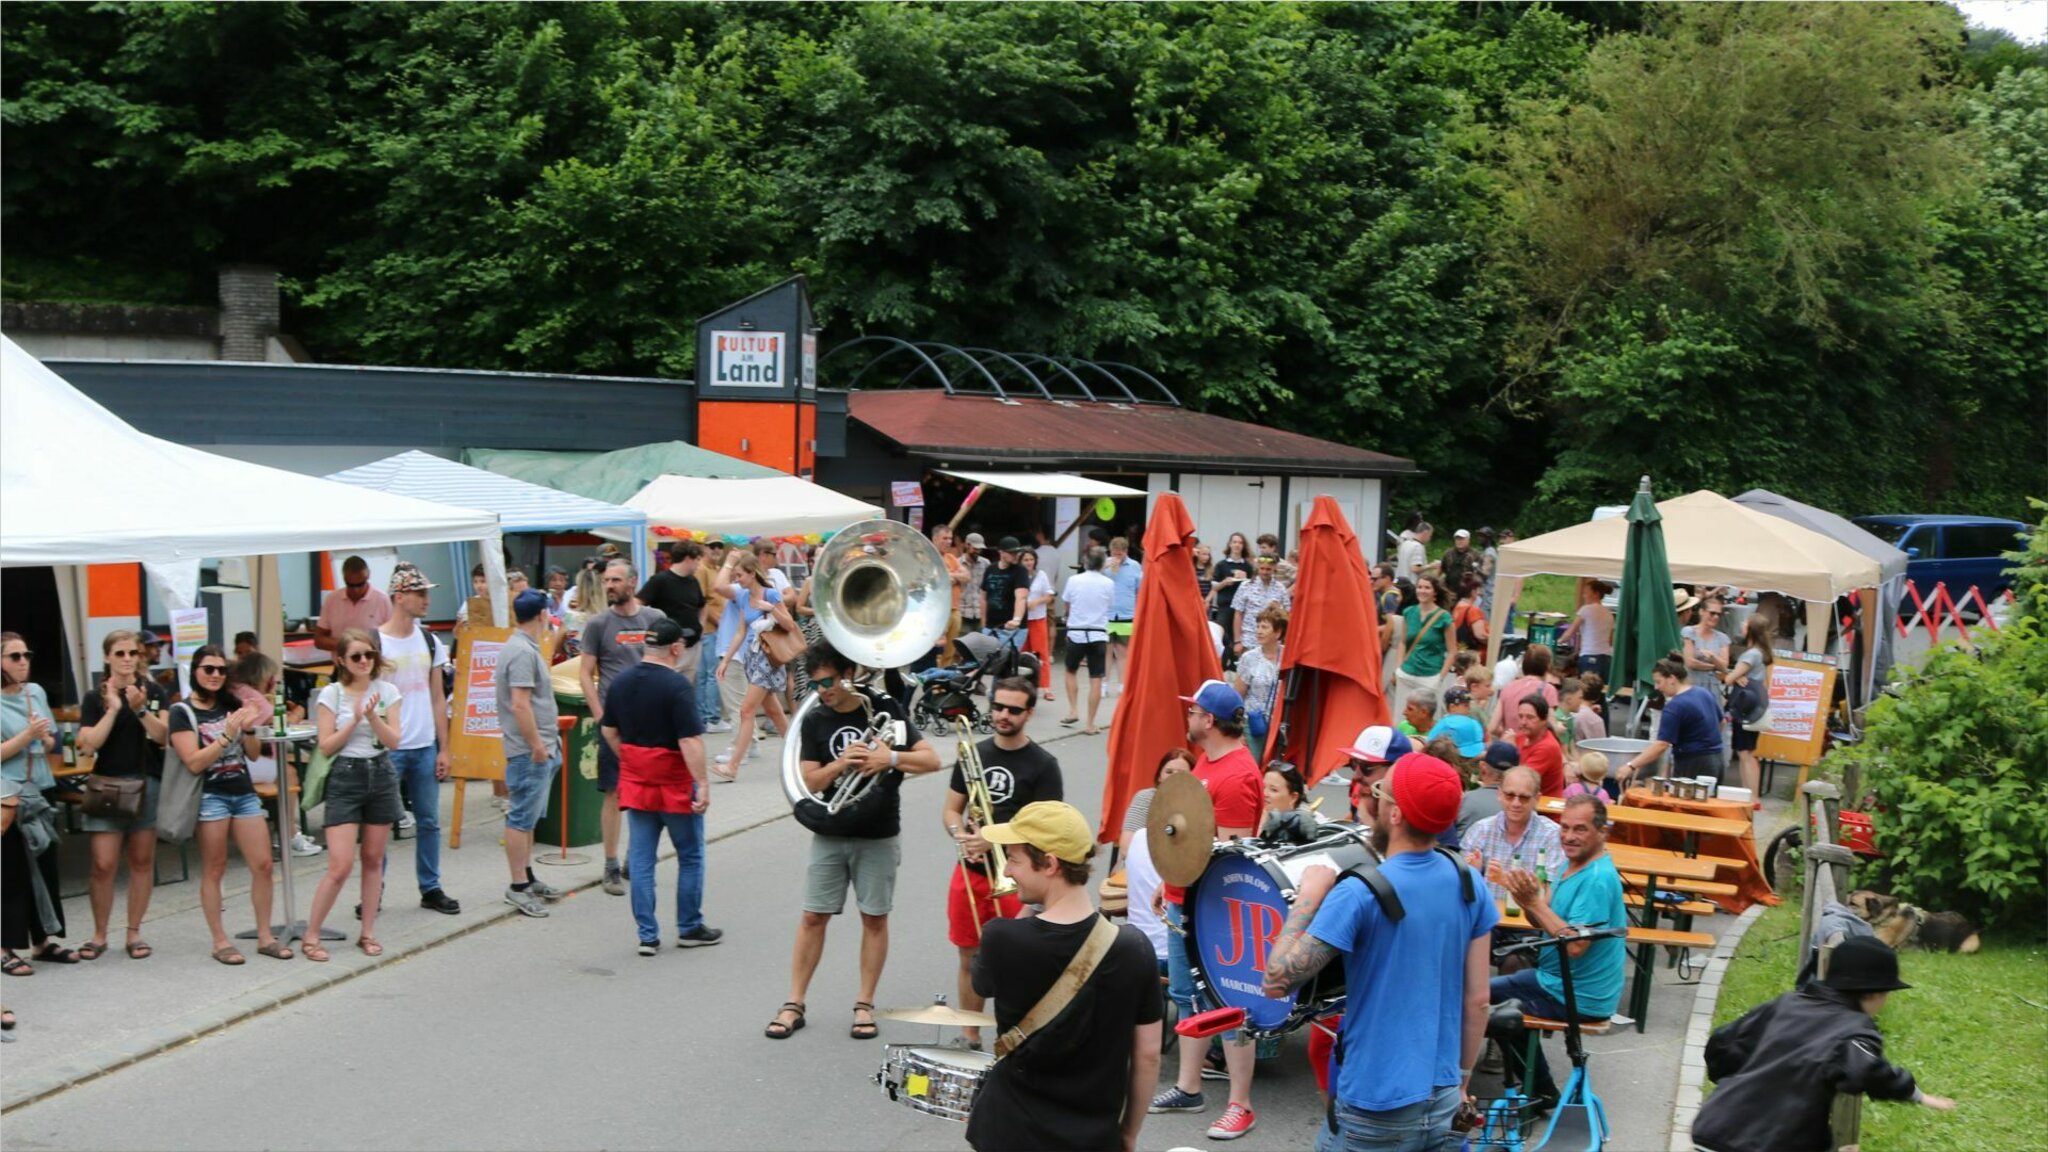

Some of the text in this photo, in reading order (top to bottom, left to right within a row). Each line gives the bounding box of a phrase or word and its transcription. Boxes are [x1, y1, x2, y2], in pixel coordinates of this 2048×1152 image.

[717, 336, 778, 352] KULTUR
[717, 351, 778, 382] Land
[1224, 874, 1270, 892] JOHN BLOW
[1221, 977, 1265, 996] MARCHING
